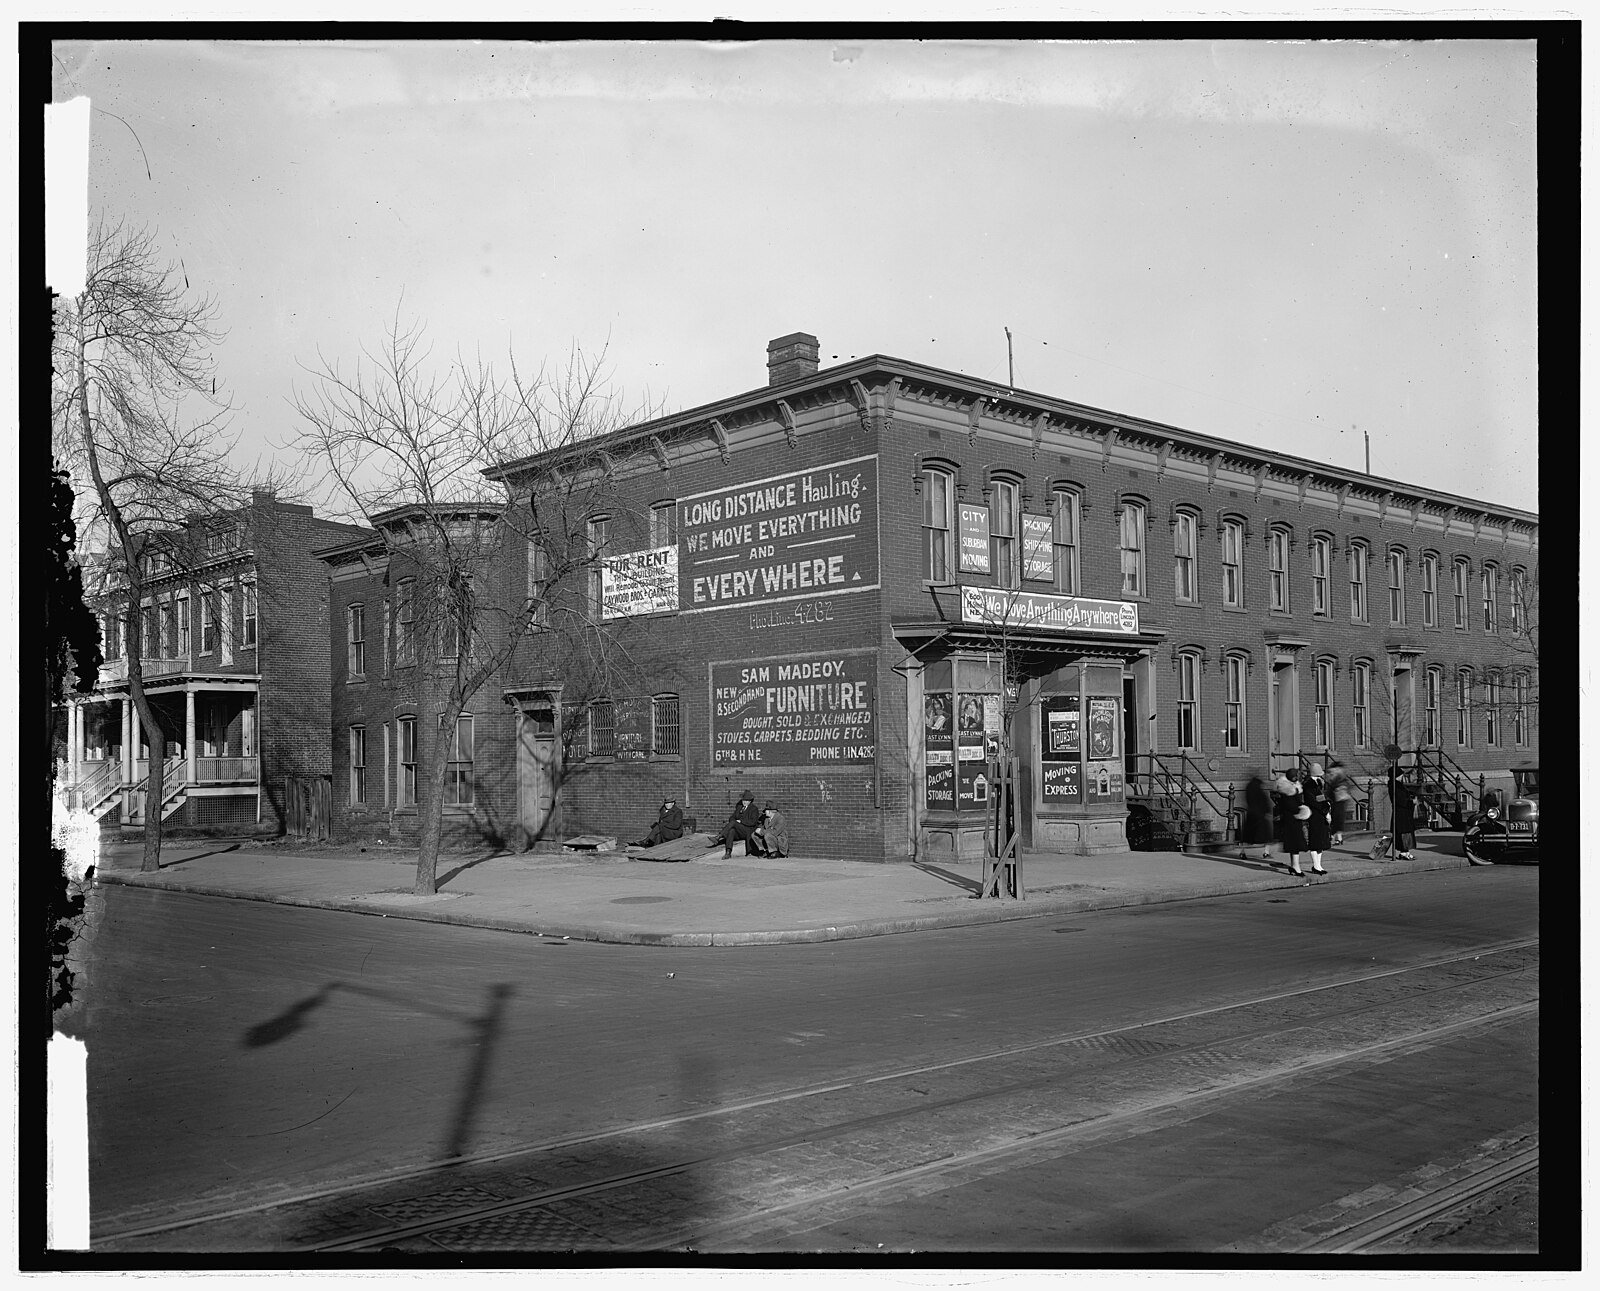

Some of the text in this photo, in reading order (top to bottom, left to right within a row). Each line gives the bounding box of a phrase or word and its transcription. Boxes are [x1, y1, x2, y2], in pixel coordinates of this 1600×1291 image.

[684, 500, 722, 528] LONG
[725, 483, 797, 519] DISTANCE
[962, 510, 986, 523] CITY
[687, 503, 862, 553] WE MOVE EVERYTHING
[1023, 519, 1052, 533] PACKING
[962, 536, 988, 549] SUBURBAN
[1024, 538, 1052, 553] SHIPPING
[749, 545, 775, 560] AND
[962, 552, 989, 567] MOVING
[609, 550, 670, 574] FOR RENT
[1024, 559, 1052, 574] STORAGE
[632, 566, 666, 579] BUILDING
[693, 555, 845, 603] EVERYWHERE
[604, 592, 630, 606] CAYWOOD
[985, 594, 1001, 615] We
[1002, 597, 1027, 618] Move
[741, 667, 770, 683] SAM
[717, 681, 867, 714] NEW FURNITURE
[776, 714, 802, 728] SOLD
[813, 711, 871, 727] EXCHANGED
[795, 727, 840, 742] BEDDING
[843, 726, 867, 740] ETC.
[739, 749, 746, 761] H
[810, 746, 841, 760] PHONE
[928, 769, 953, 787] PACKING
[1044, 765, 1077, 783] MOVING
[927, 790, 953, 801] STORAGE
[1044, 784, 1078, 796] EXPRESS
